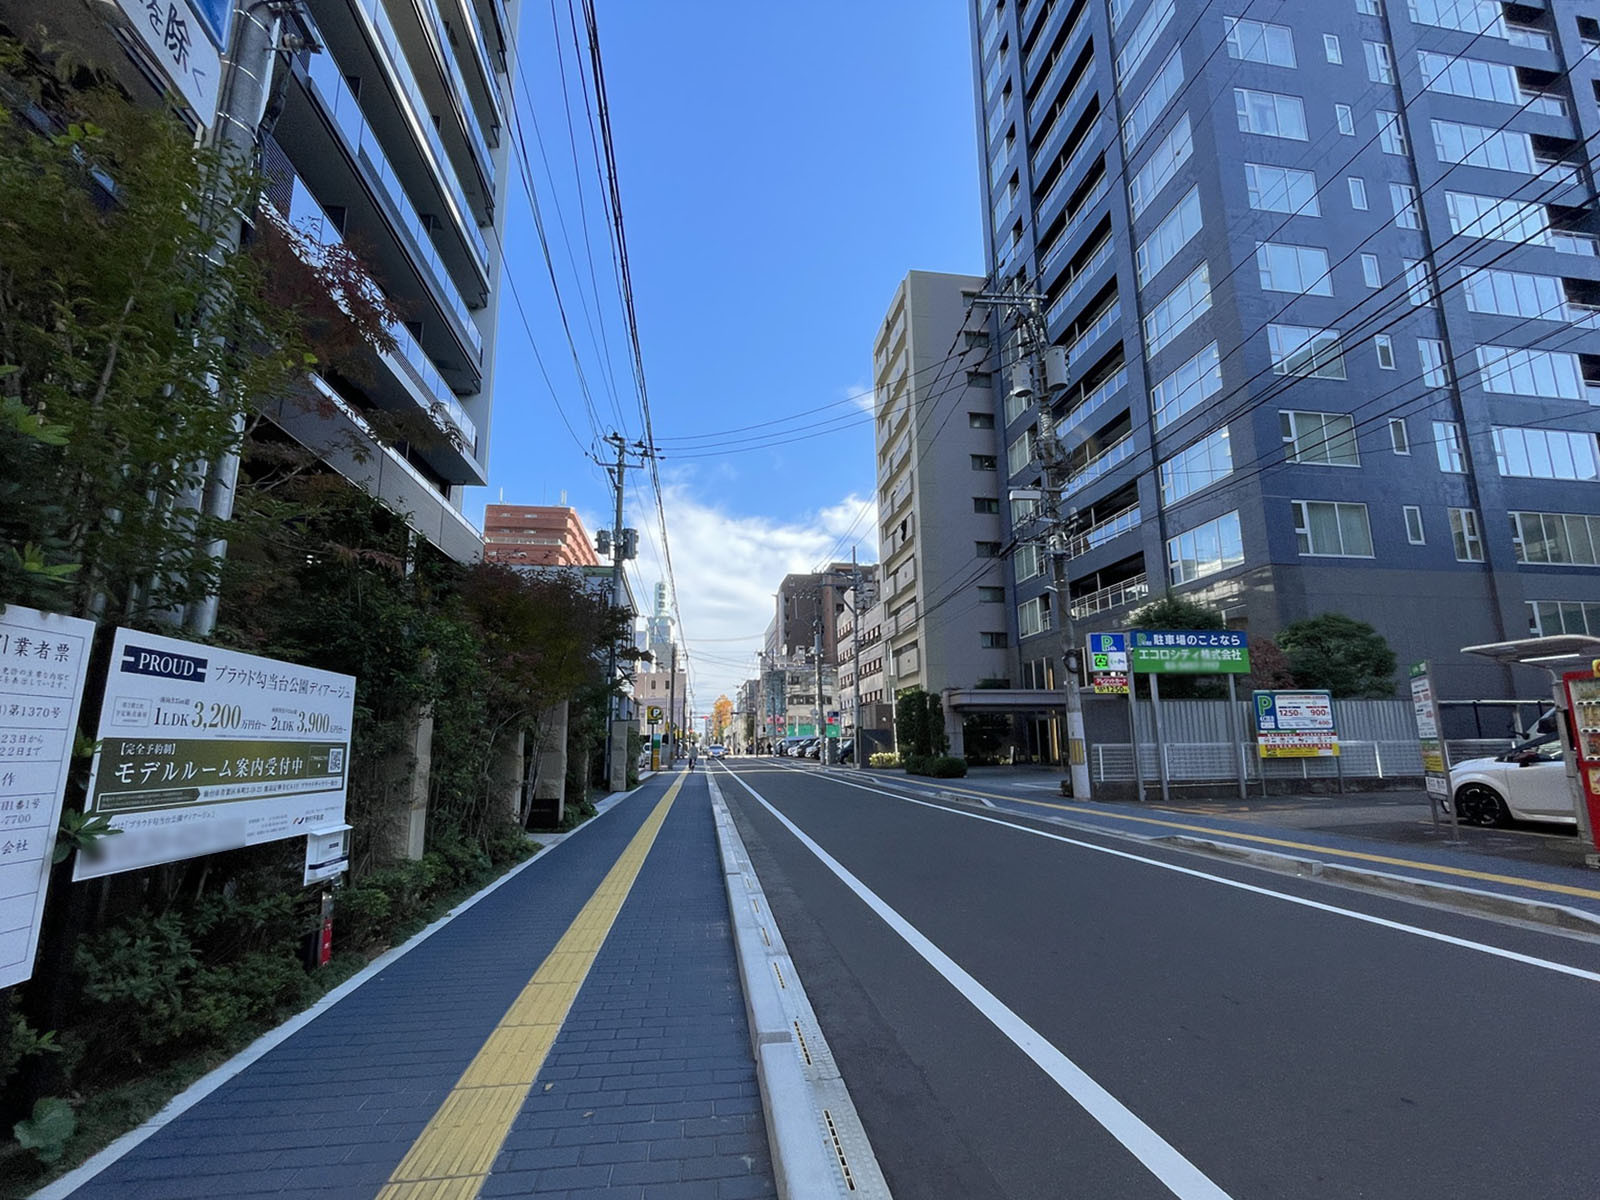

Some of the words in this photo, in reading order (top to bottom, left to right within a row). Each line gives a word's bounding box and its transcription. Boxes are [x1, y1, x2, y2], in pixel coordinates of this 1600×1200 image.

[1153, 634, 1241, 646] 駐車場のことなら
[1094, 653, 1108, 667] 空
[1139, 649, 1242, 661] エコロシティ株式会社
[138, 652, 195, 676] PROUD
[215, 665, 351, 699] プラウド勾当台公園ディアージュ
[0, 704, 61, 719] )第1370号
[1257, 695, 1273, 716] P
[114, 756, 304, 785] モデルルーム案内受付中
[2, 840, 29, 855] 会社
